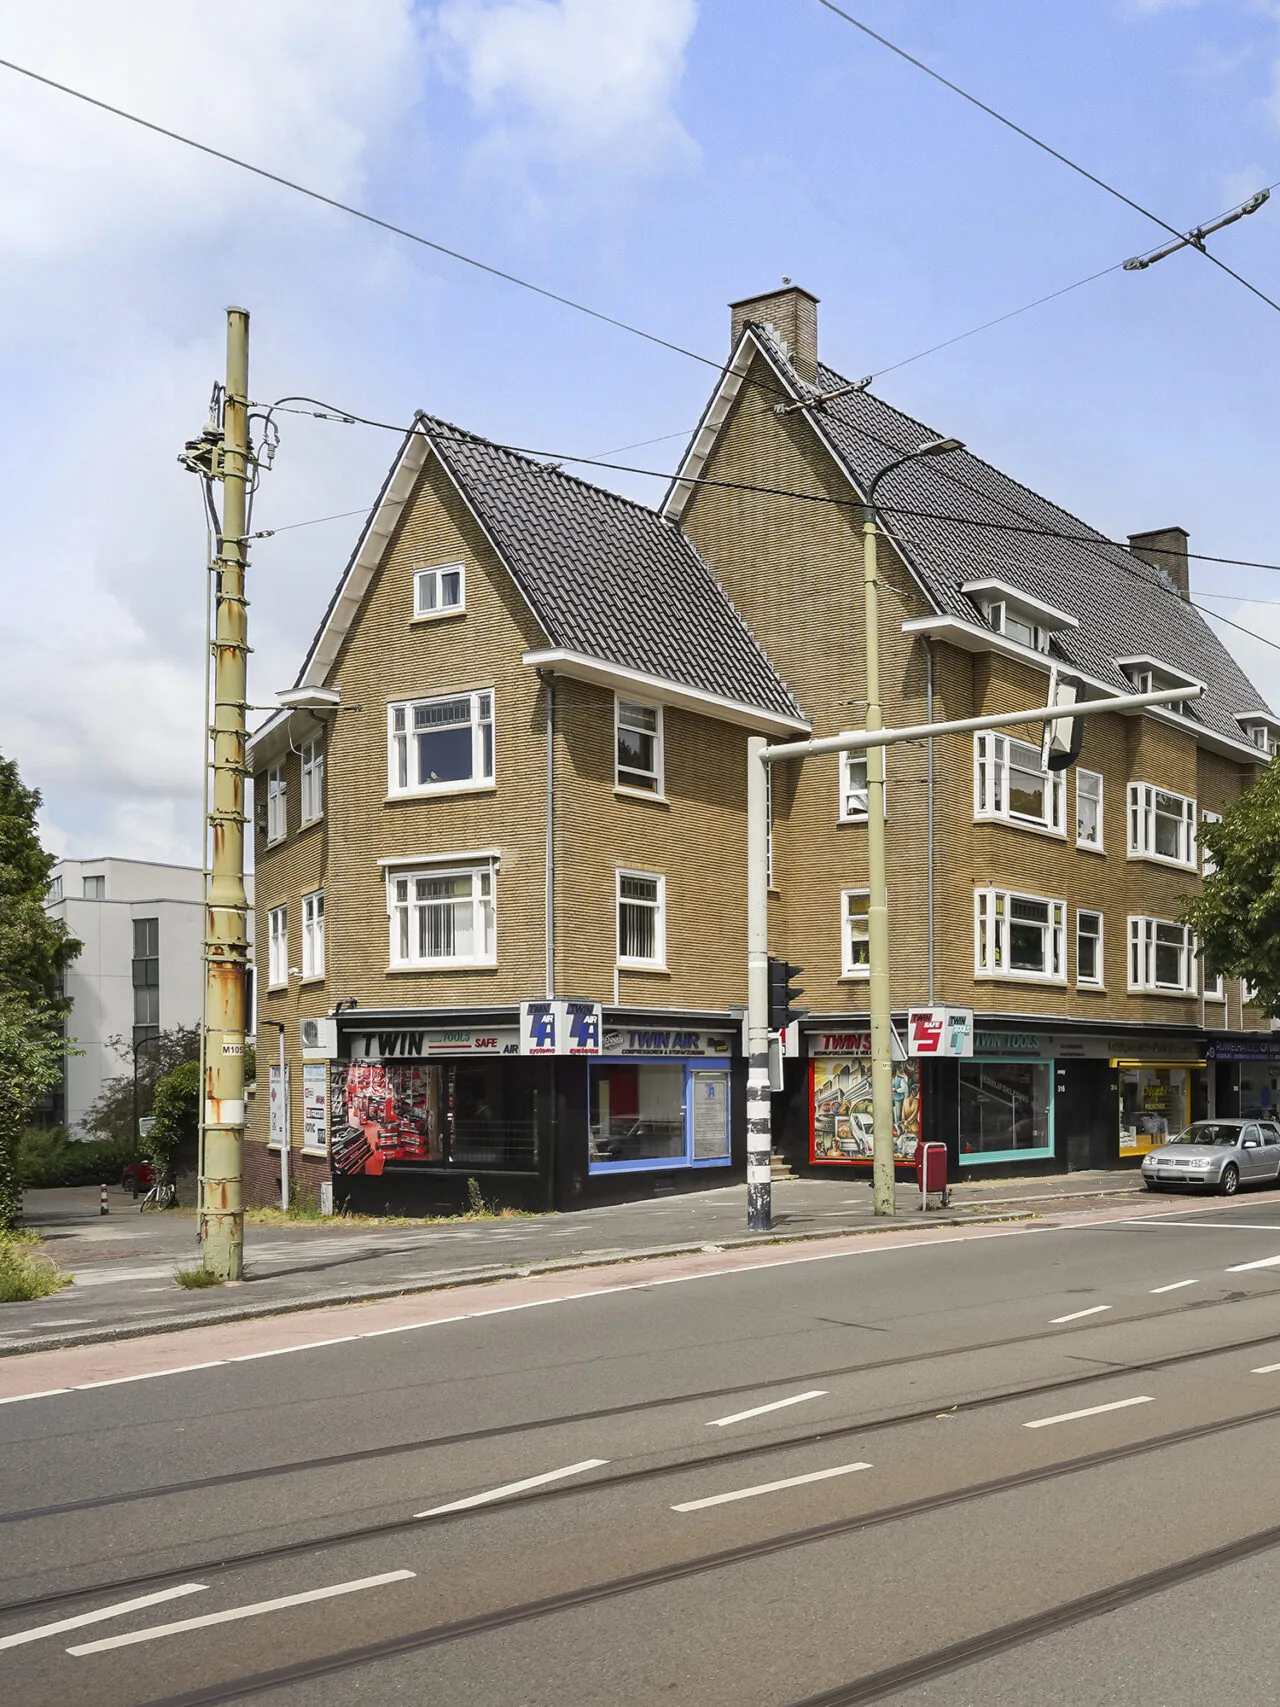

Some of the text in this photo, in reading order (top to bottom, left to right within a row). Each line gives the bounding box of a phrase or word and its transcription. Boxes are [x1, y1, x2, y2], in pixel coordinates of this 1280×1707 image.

[541, 1015, 554, 1023] AIR
[583, 1015, 597, 1023] AIR
[949, 1016, 966, 1025] TWIN
[442, 1032, 470, 1042] TOOLS
[627, 1031, 670, 1049] TWIN
[672, 1031, 700, 1050] AIR
[823, 1034, 860, 1050] TWIN
[974, 1033, 1039, 1048] TWIN TOOLS
[362, 1031, 424, 1057] TWIN
[475, 1038, 498, 1048] SAFE
[503, 1044, 518, 1054] AIR
